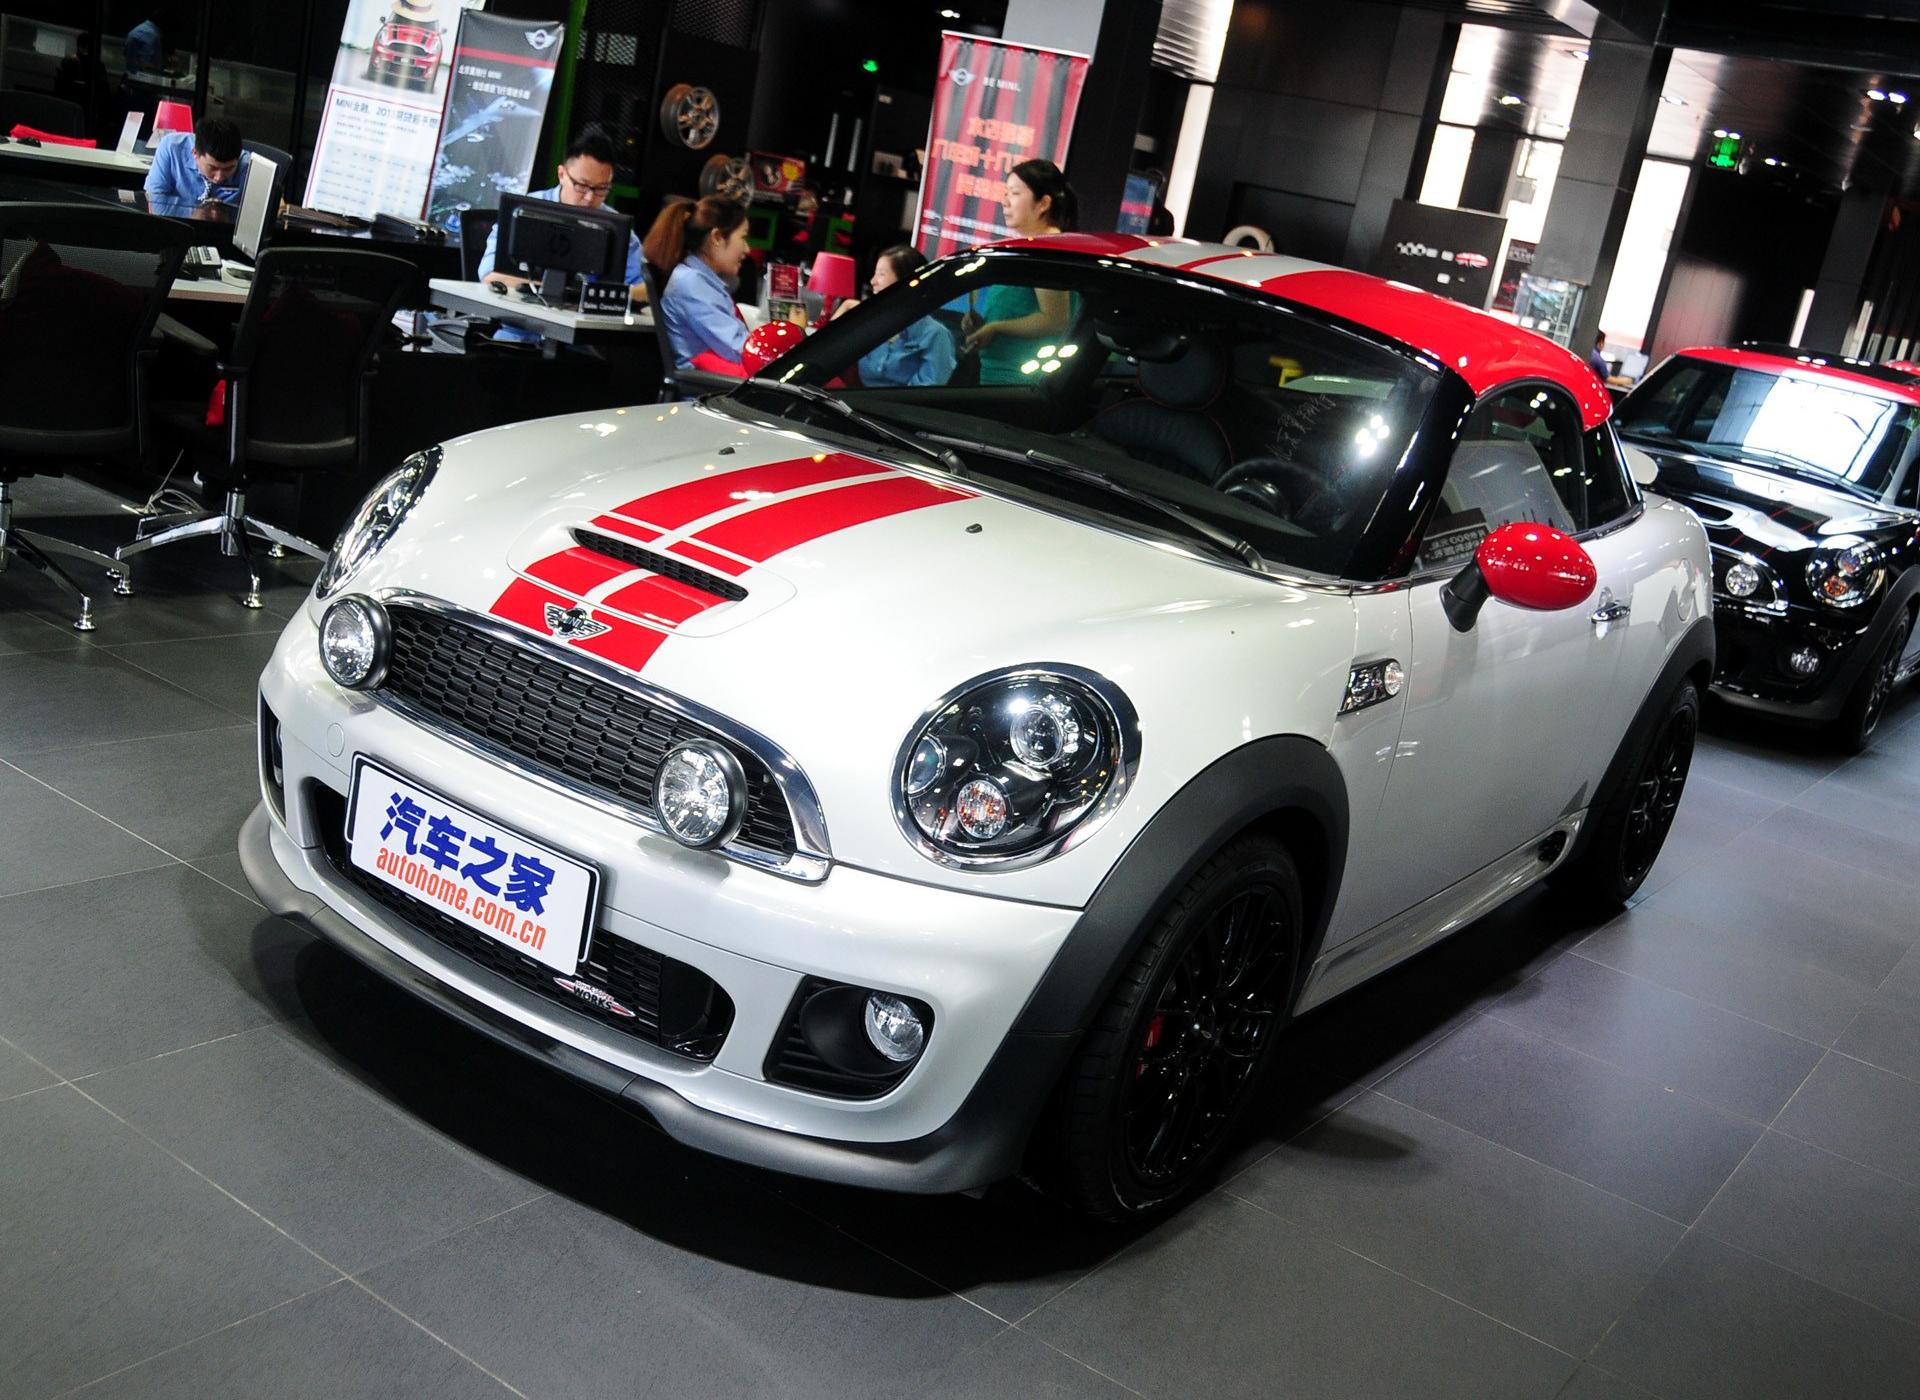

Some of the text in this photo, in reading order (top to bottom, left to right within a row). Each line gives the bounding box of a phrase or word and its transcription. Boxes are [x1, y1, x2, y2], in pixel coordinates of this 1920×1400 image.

[376, 847, 547, 950] autohome.com.cn
[380, 792, 555, 916] 汽车之家
[574, 986, 613, 1010] WORKS
